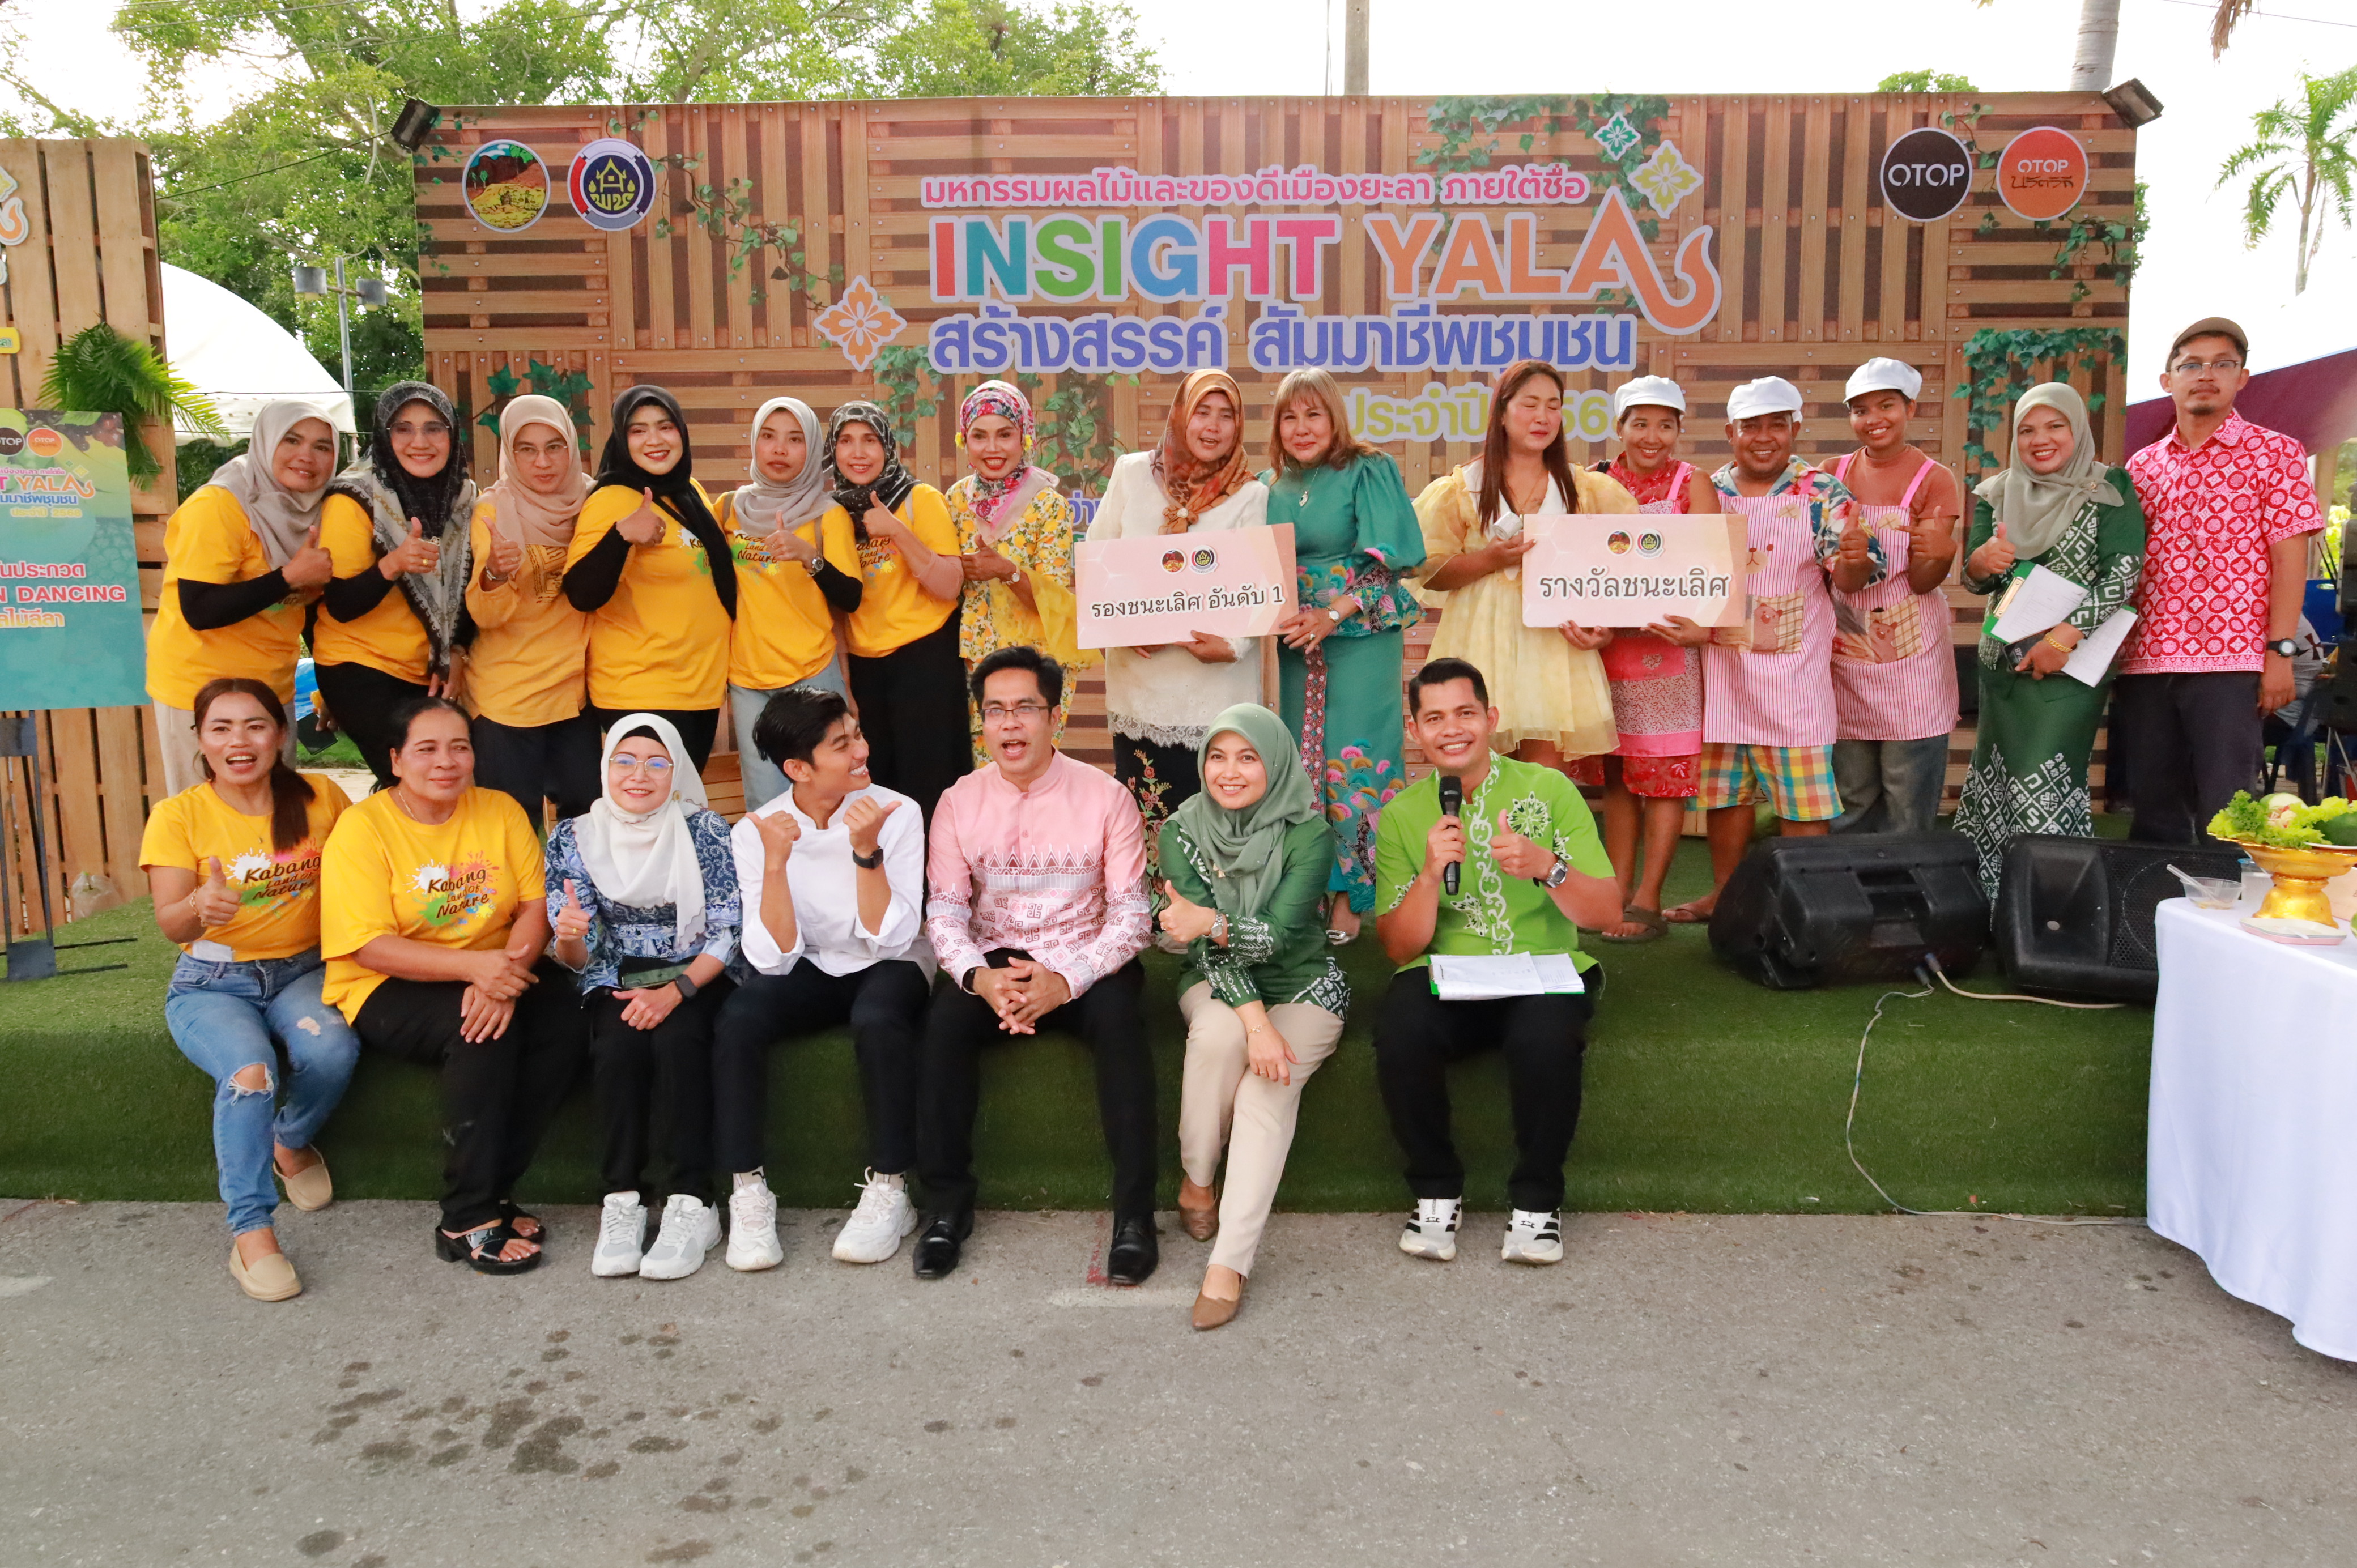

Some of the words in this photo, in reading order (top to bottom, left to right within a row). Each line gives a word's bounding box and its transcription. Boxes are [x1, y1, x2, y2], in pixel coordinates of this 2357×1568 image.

[1888, 163, 1965, 187] OTOP
[2017, 159, 2069, 173] OTOP
[925, 169, 1431, 203] มหกรรมผลไม้และของดีเมืองยะลา
[1444, 164, 1586, 200] ภายใต้ชื่อ
[935, 219, 1336, 297] INSIGHT
[1369, 195, 1717, 330] YALA
[934, 305, 1223, 368] สร้างสรรค์
[16, 474, 95, 498] YALA
[18, 586, 126, 602] DANCING
[1539, 567, 1730, 598] รางวัลชนะเลิศ
[1091, 590, 1202, 618] รองชนะเลิศ
[1207, 583, 1265, 610] อันดับ
[1272, 585, 1284, 603] 1
[244, 856, 321, 884] Kabang
[265, 873, 298, 889] Land
[427, 868, 486, 893] Kabang
[436, 893, 490, 918] Nature
